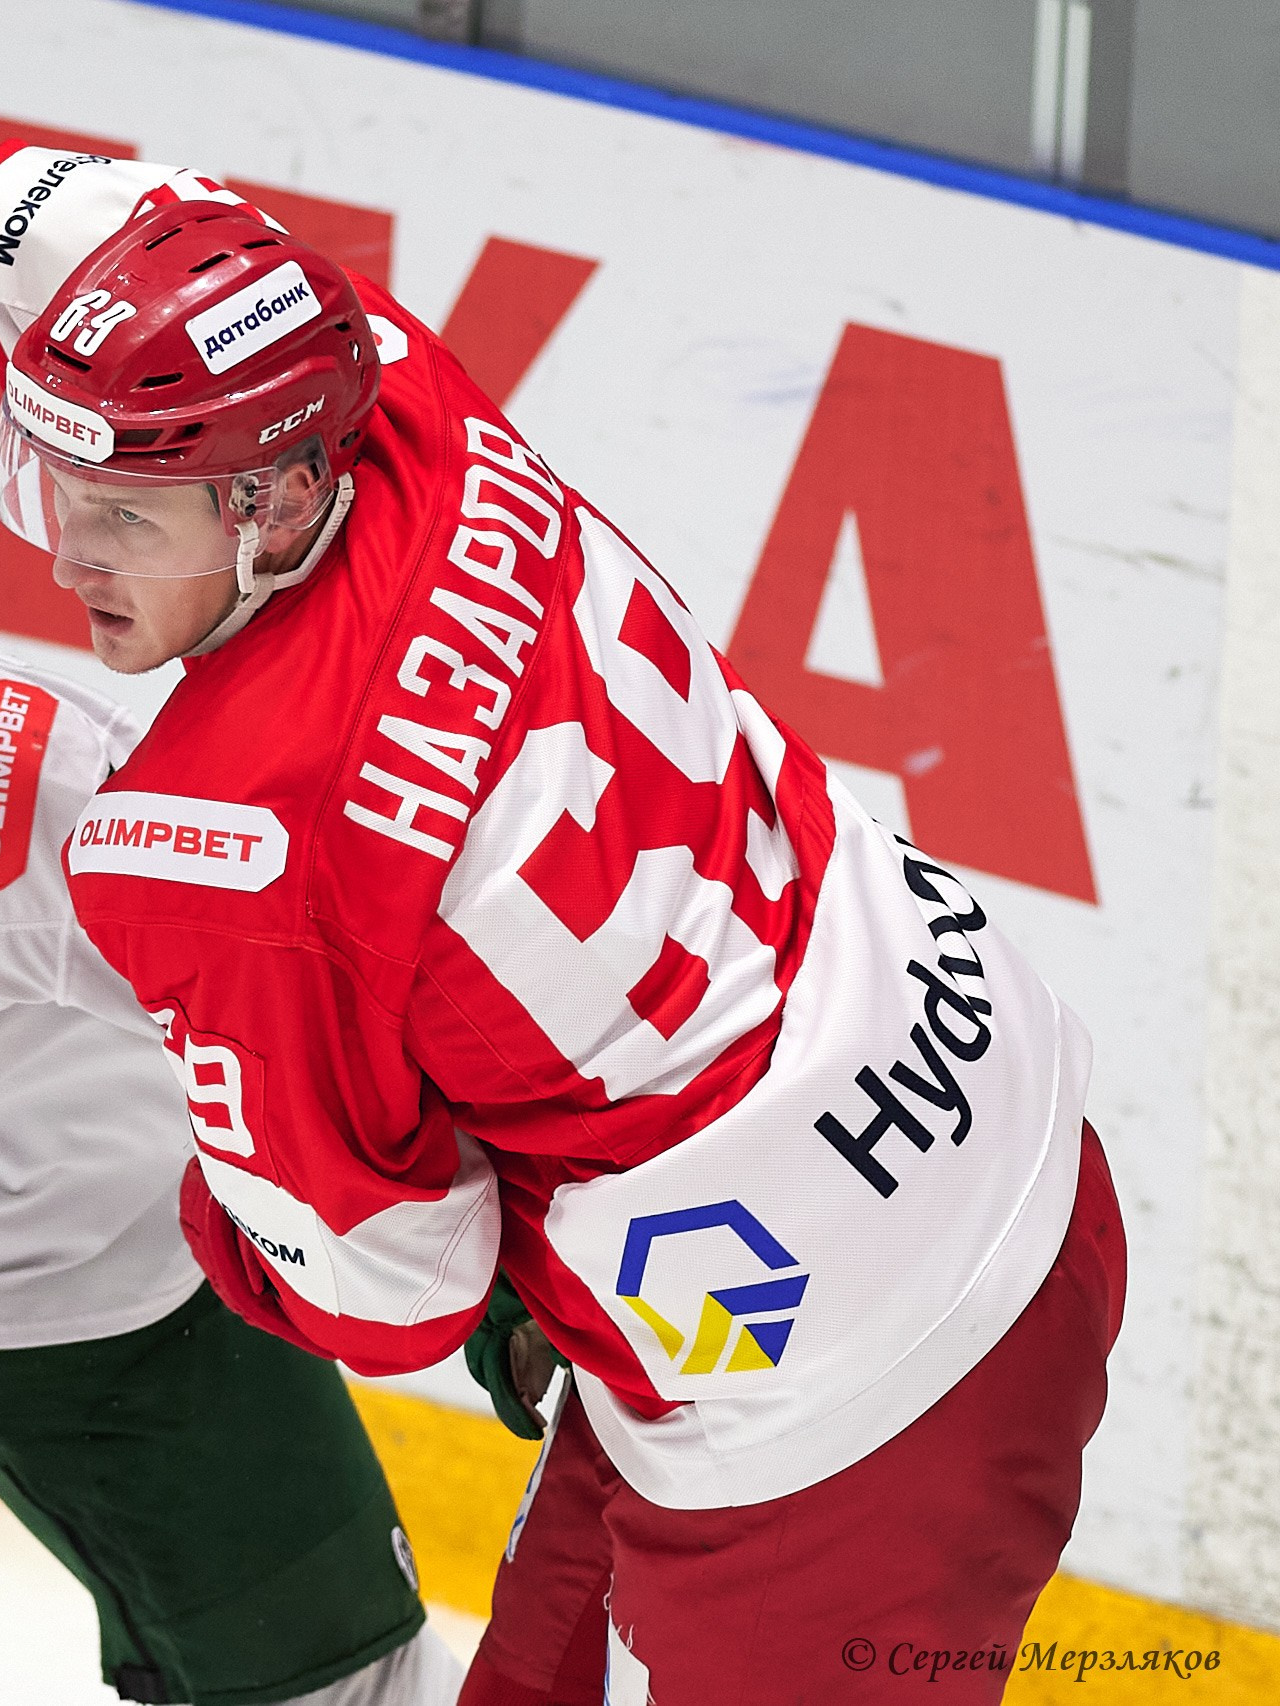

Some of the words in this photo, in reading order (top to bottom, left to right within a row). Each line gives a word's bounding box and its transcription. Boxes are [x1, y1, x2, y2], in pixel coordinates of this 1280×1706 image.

[49, 288, 138, 358] 69
[204, 282, 310, 360] датабанк
[258, 394, 326, 445] CCM
[342, 416, 564, 863] НАЗАРОВ
[79, 818, 263, 863] OLIMPBET
[437, 505, 802, 1102] 69
